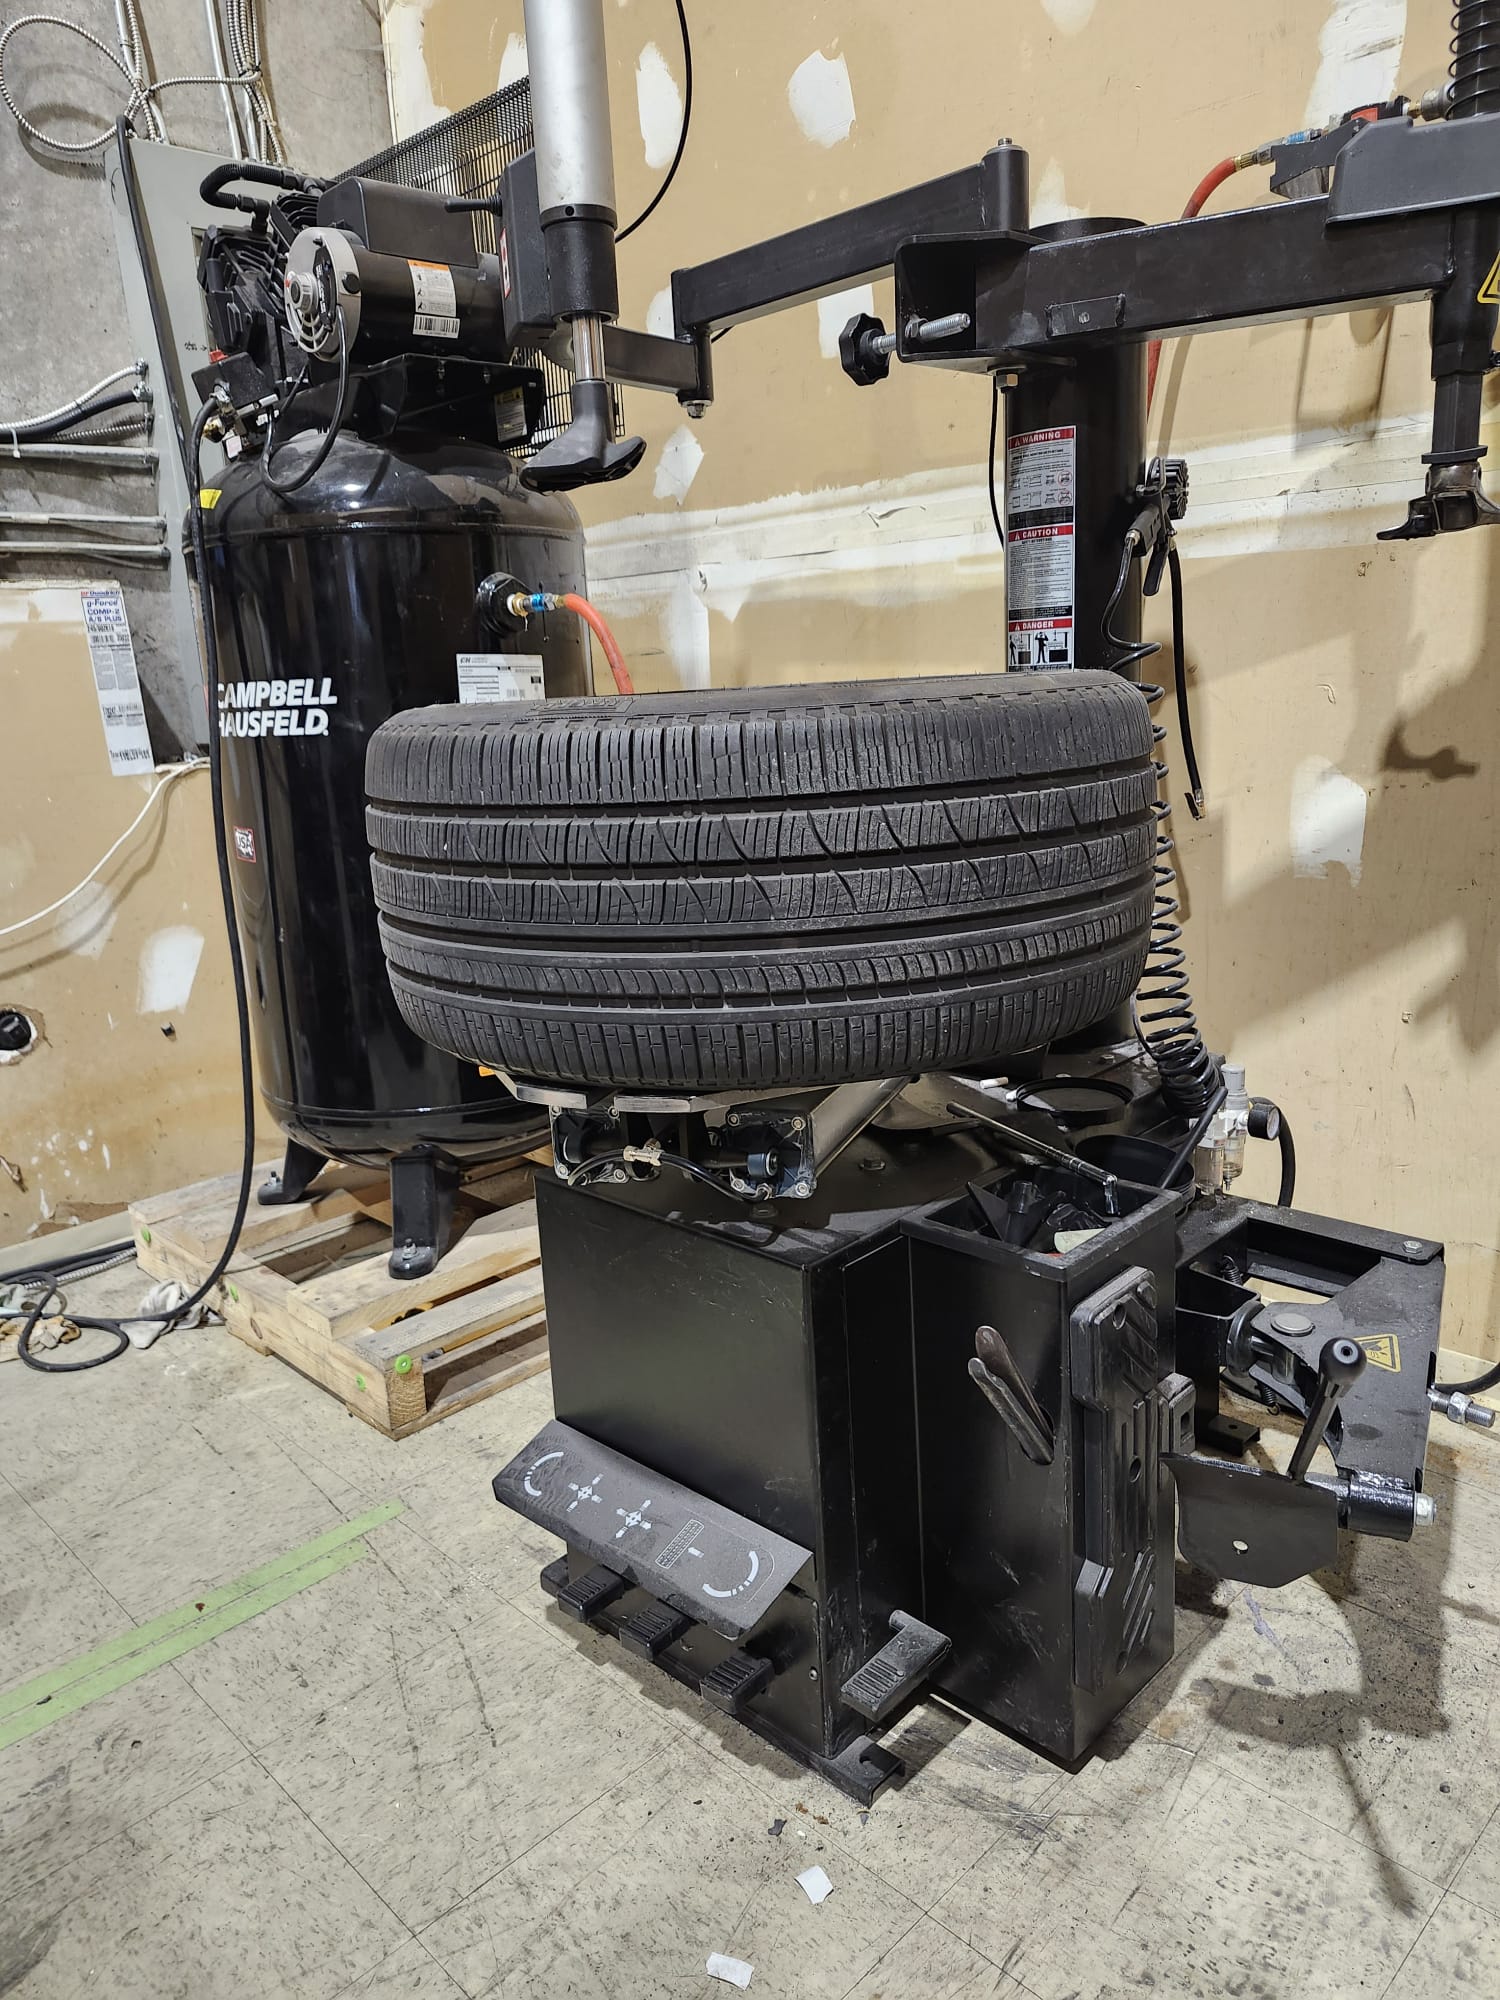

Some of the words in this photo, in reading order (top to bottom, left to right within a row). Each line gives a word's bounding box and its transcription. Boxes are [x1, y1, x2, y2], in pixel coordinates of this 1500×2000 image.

[1022, 431, 1061, 444] WARNING
[1022, 527, 1059, 539] CAUTION
[1022, 620, 1054, 630] DANGER
